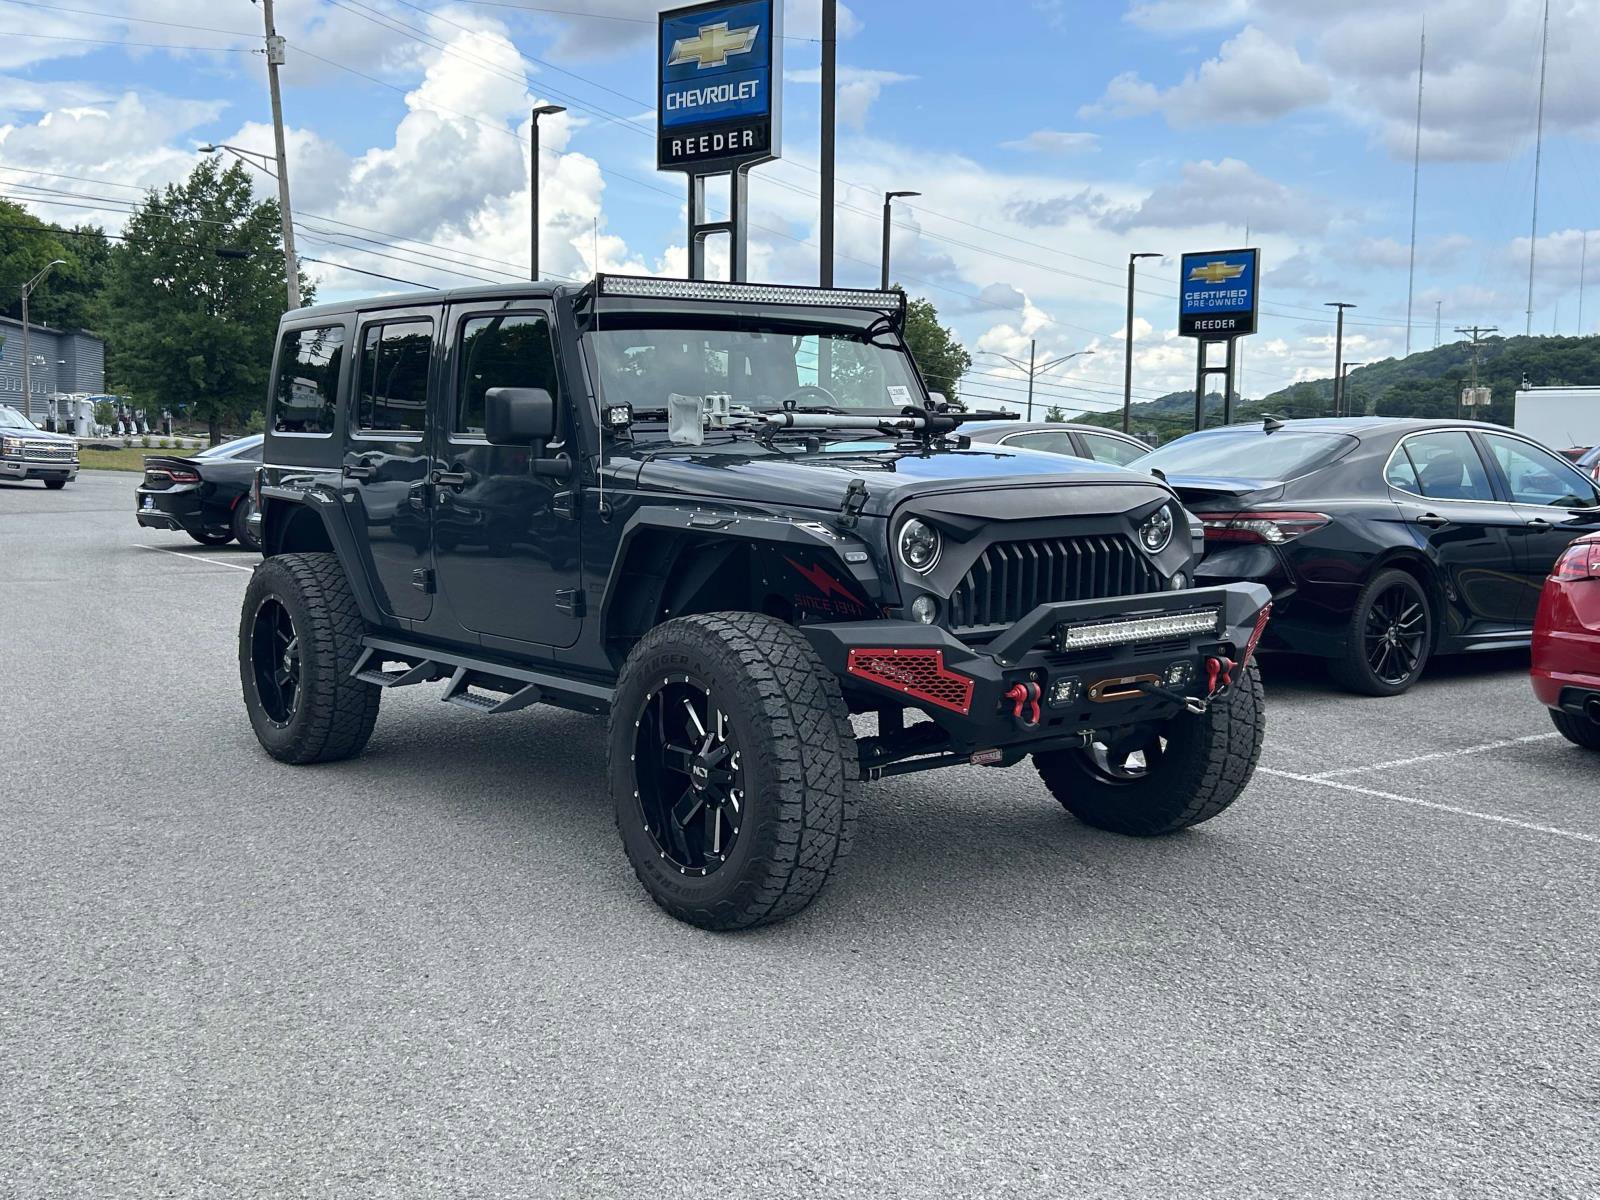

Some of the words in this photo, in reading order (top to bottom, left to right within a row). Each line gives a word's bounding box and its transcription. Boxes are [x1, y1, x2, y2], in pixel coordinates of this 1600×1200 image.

[666, 80, 759, 111] CHEVROLET
[672, 130, 753, 156] REEDER
[1185, 289, 1248, 300] CERTIFIED
[1187, 298, 1244, 307] PRE-OWNED
[1194, 320, 1235, 330] REEDER
